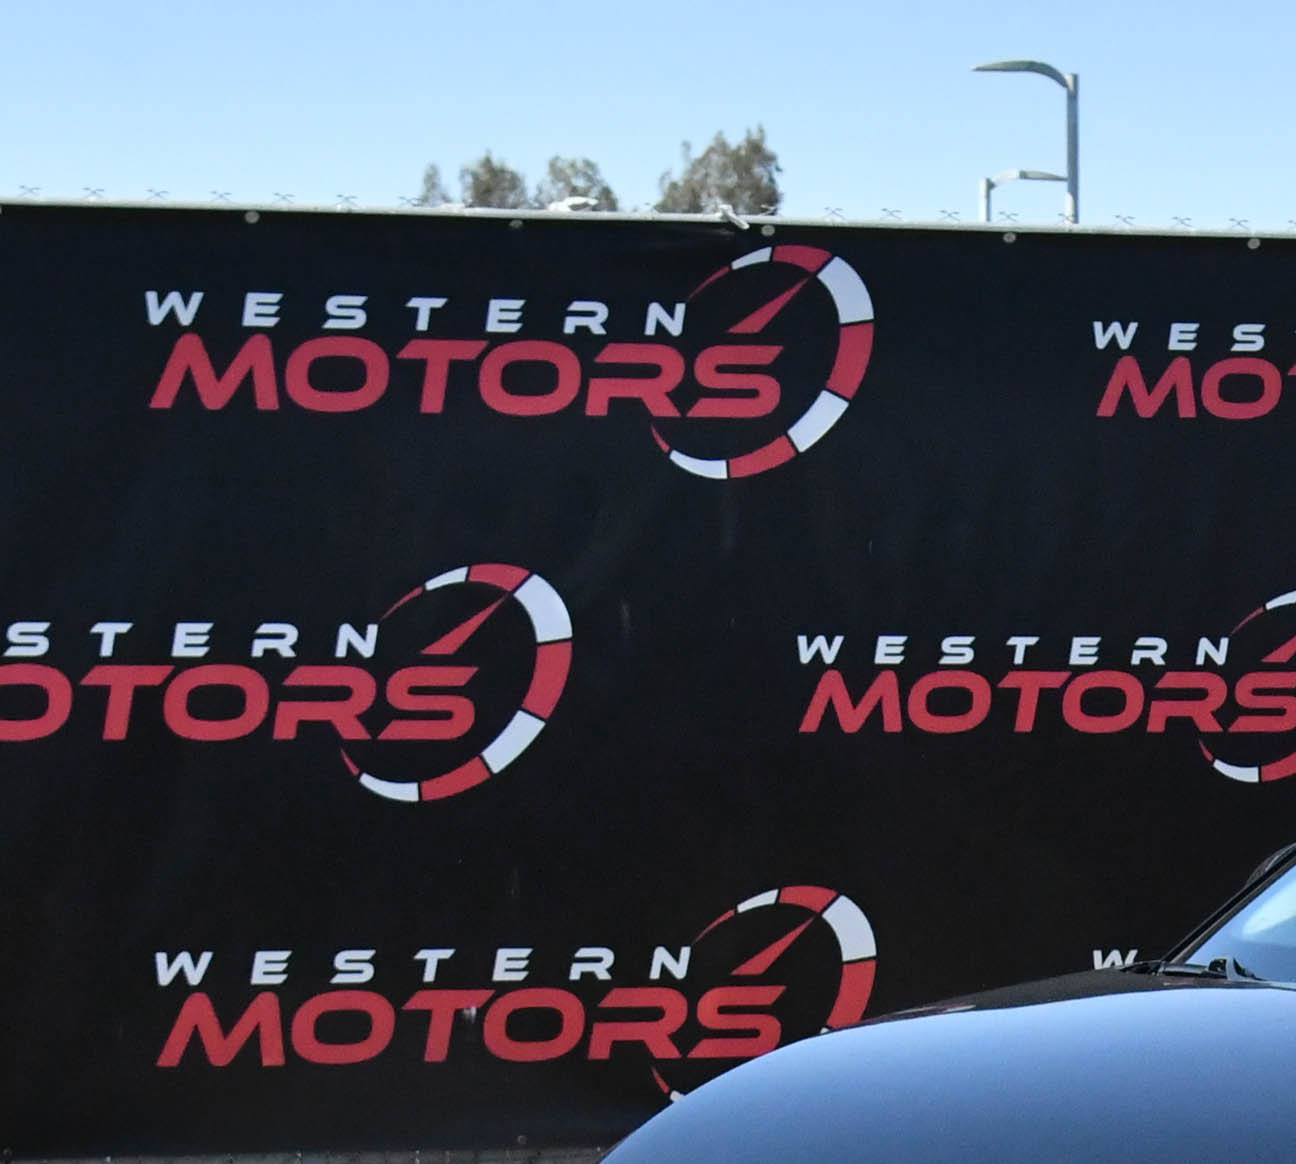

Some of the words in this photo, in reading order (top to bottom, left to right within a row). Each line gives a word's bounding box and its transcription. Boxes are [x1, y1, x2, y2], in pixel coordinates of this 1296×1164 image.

[146, 290, 687, 337] WESTERN
[150, 333, 784, 418] MOTORS
[3, 621, 379, 658] STERN
[797, 635, 1229, 666] WESTERN
[155, 946, 691, 986] WESTERN
[156, 986, 787, 1068] MOTORS
